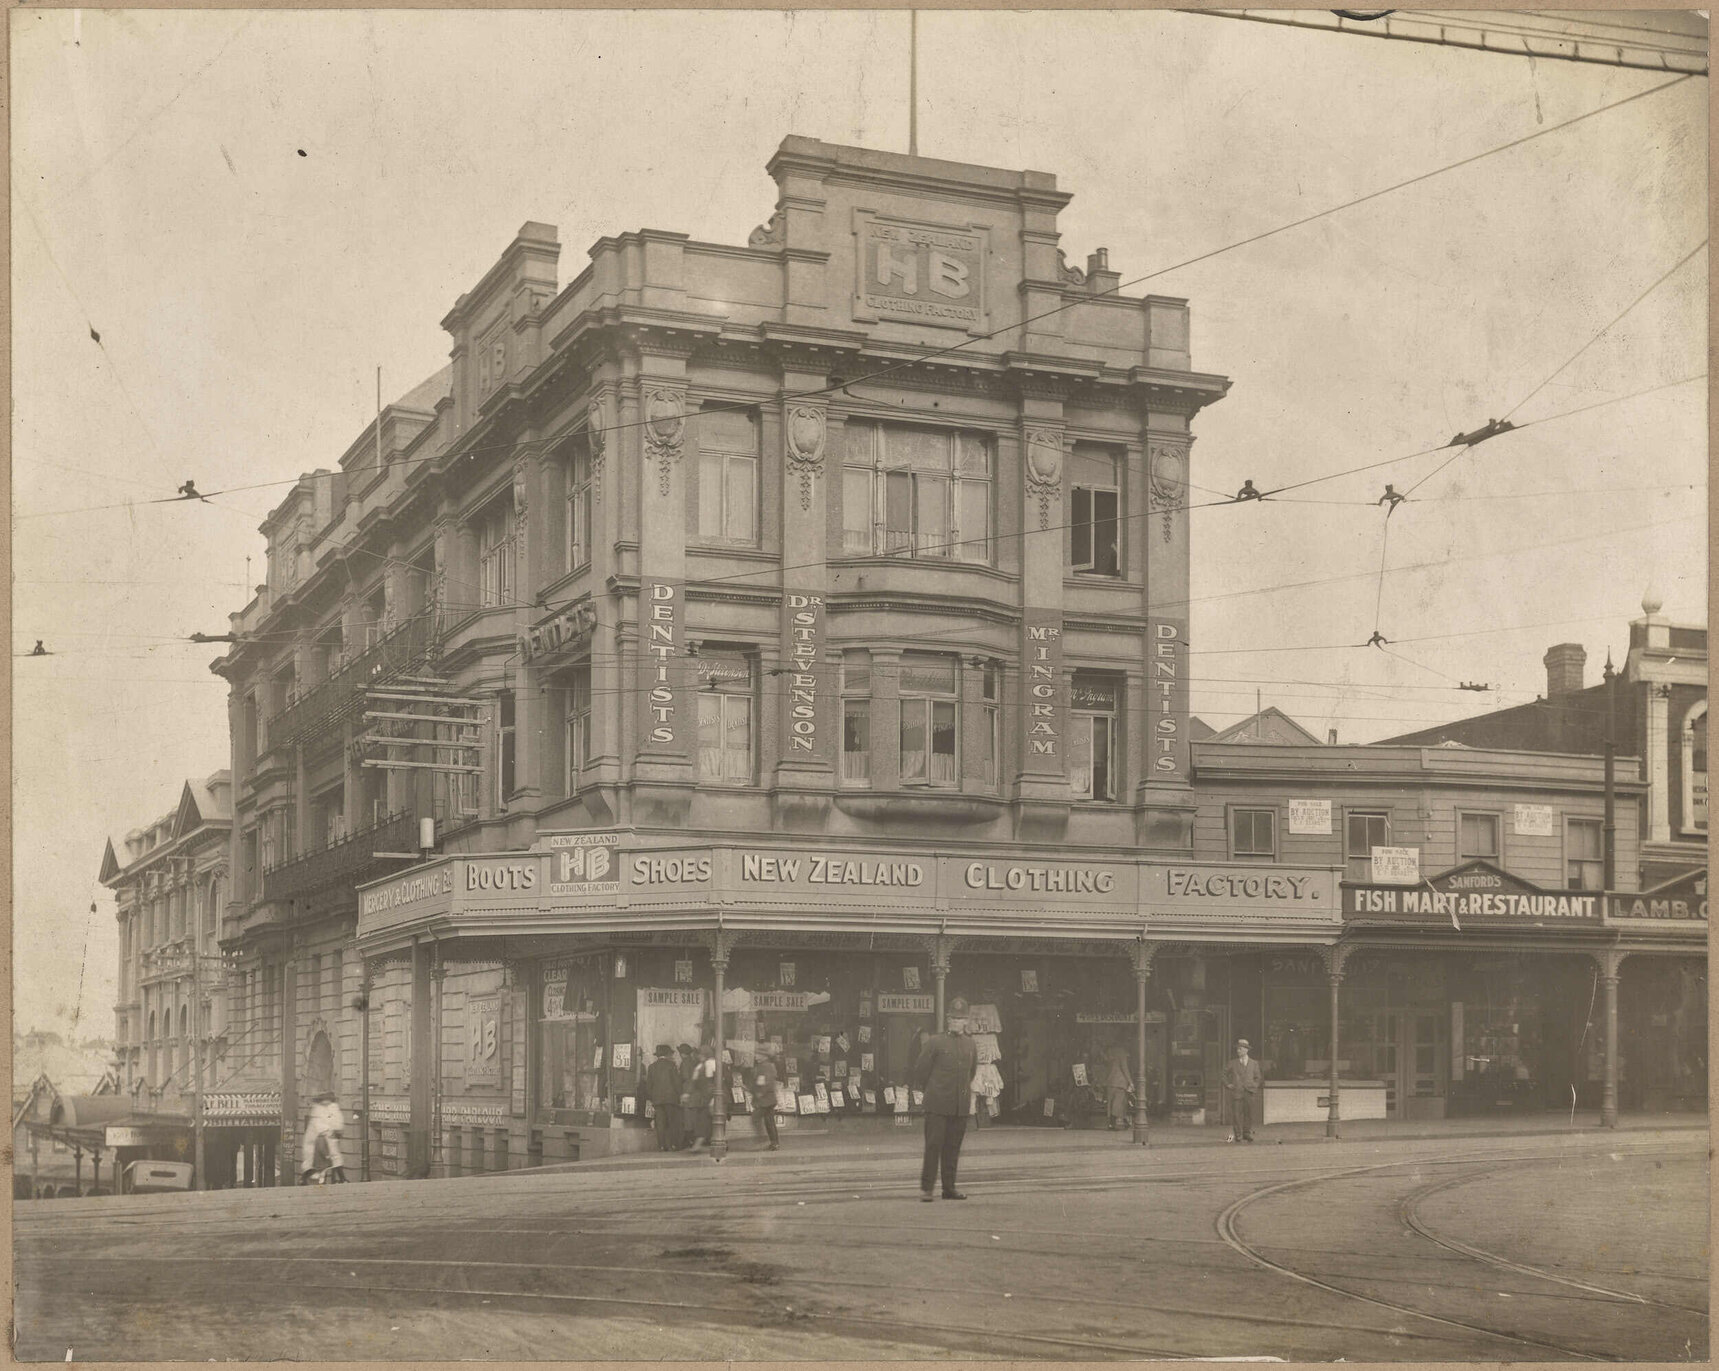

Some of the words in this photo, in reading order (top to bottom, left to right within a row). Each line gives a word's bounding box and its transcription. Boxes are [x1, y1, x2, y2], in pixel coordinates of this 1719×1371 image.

[876, 241, 970, 299] HB
[866, 298, 922, 314] CLOTHING
[925, 303, 978, 321] FACTORY
[650, 583, 676, 743] DENTISTS
[791, 612, 817, 751] STEVENSON
[1030, 646, 1058, 755] INGRAM
[1155, 623, 1178, 772] DENTISTS
[1290, 807, 1299, 816] BY
[1302, 807, 1330, 817] AUCTION
[552, 835, 573, 847] NEW
[575, 833, 618, 846] ZEALAND
[559, 846, 610, 882] HB
[630, 856, 713, 886] SHOES
[1373, 856, 1383, 865] BY
[1387, 857, 1417, 866] AUCTION
[401, 874, 439, 905] CLOTHING
[466, 863, 537, 890] BOOTS
[551, 883, 586, 893] CLOTHING
[587, 882, 620, 893] FACTORY
[742, 854, 801, 882] NEW
[808, 856, 923, 886] ZEALAND
[964, 862, 1116, 893] CLOTHING
[1166, 869, 1320, 901] FACTORY.
[1448, 875, 1501, 889] SANFORD'S
[1354, 890, 1396, 913] FISH
[1470, 895, 1596, 917] RESTAURANT
[648, 992, 678, 1005] SAMPLE
[681, 993, 701, 1006] SALE
[753, 996, 783, 1008] SAMPLE
[786, 997, 804, 1008] SALE
